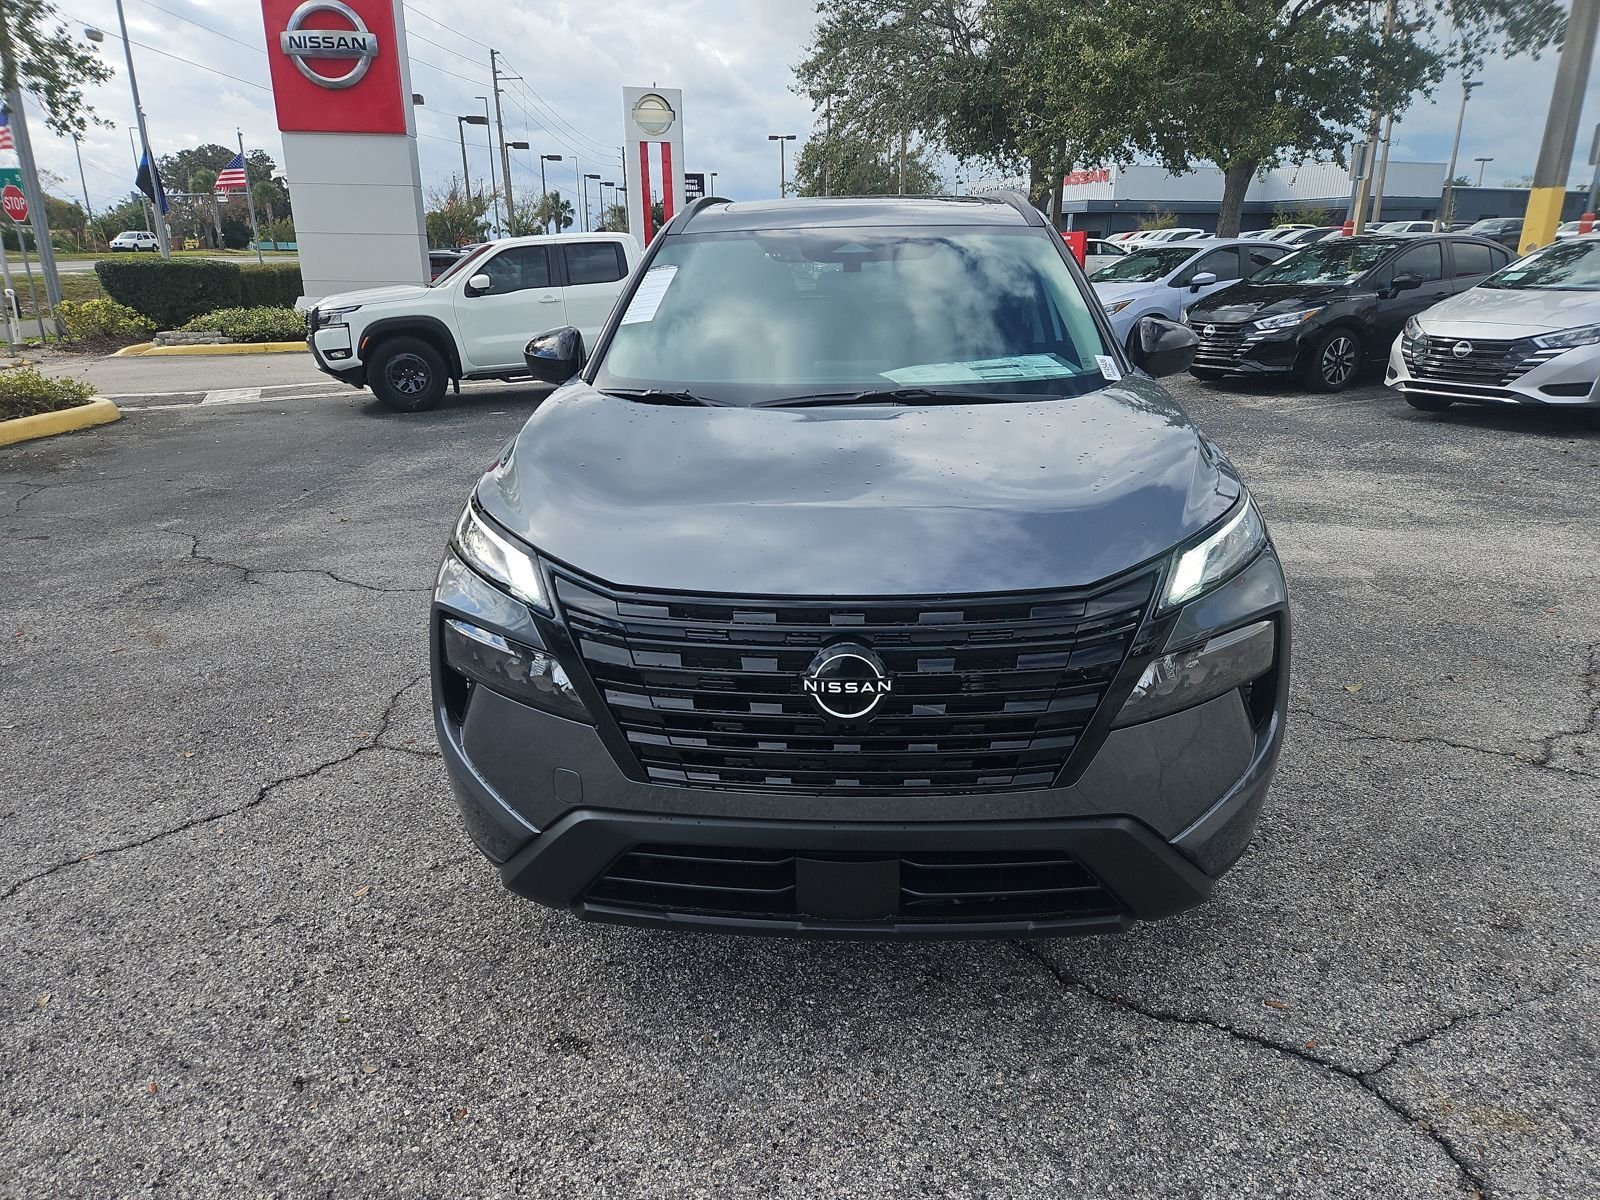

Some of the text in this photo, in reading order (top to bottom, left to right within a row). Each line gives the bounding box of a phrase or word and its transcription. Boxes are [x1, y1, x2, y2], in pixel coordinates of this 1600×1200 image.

[288, 35, 368, 51] NISSAN
[4, 196, 25, 210] STOP
[803, 679, 892, 694] NISSAN
